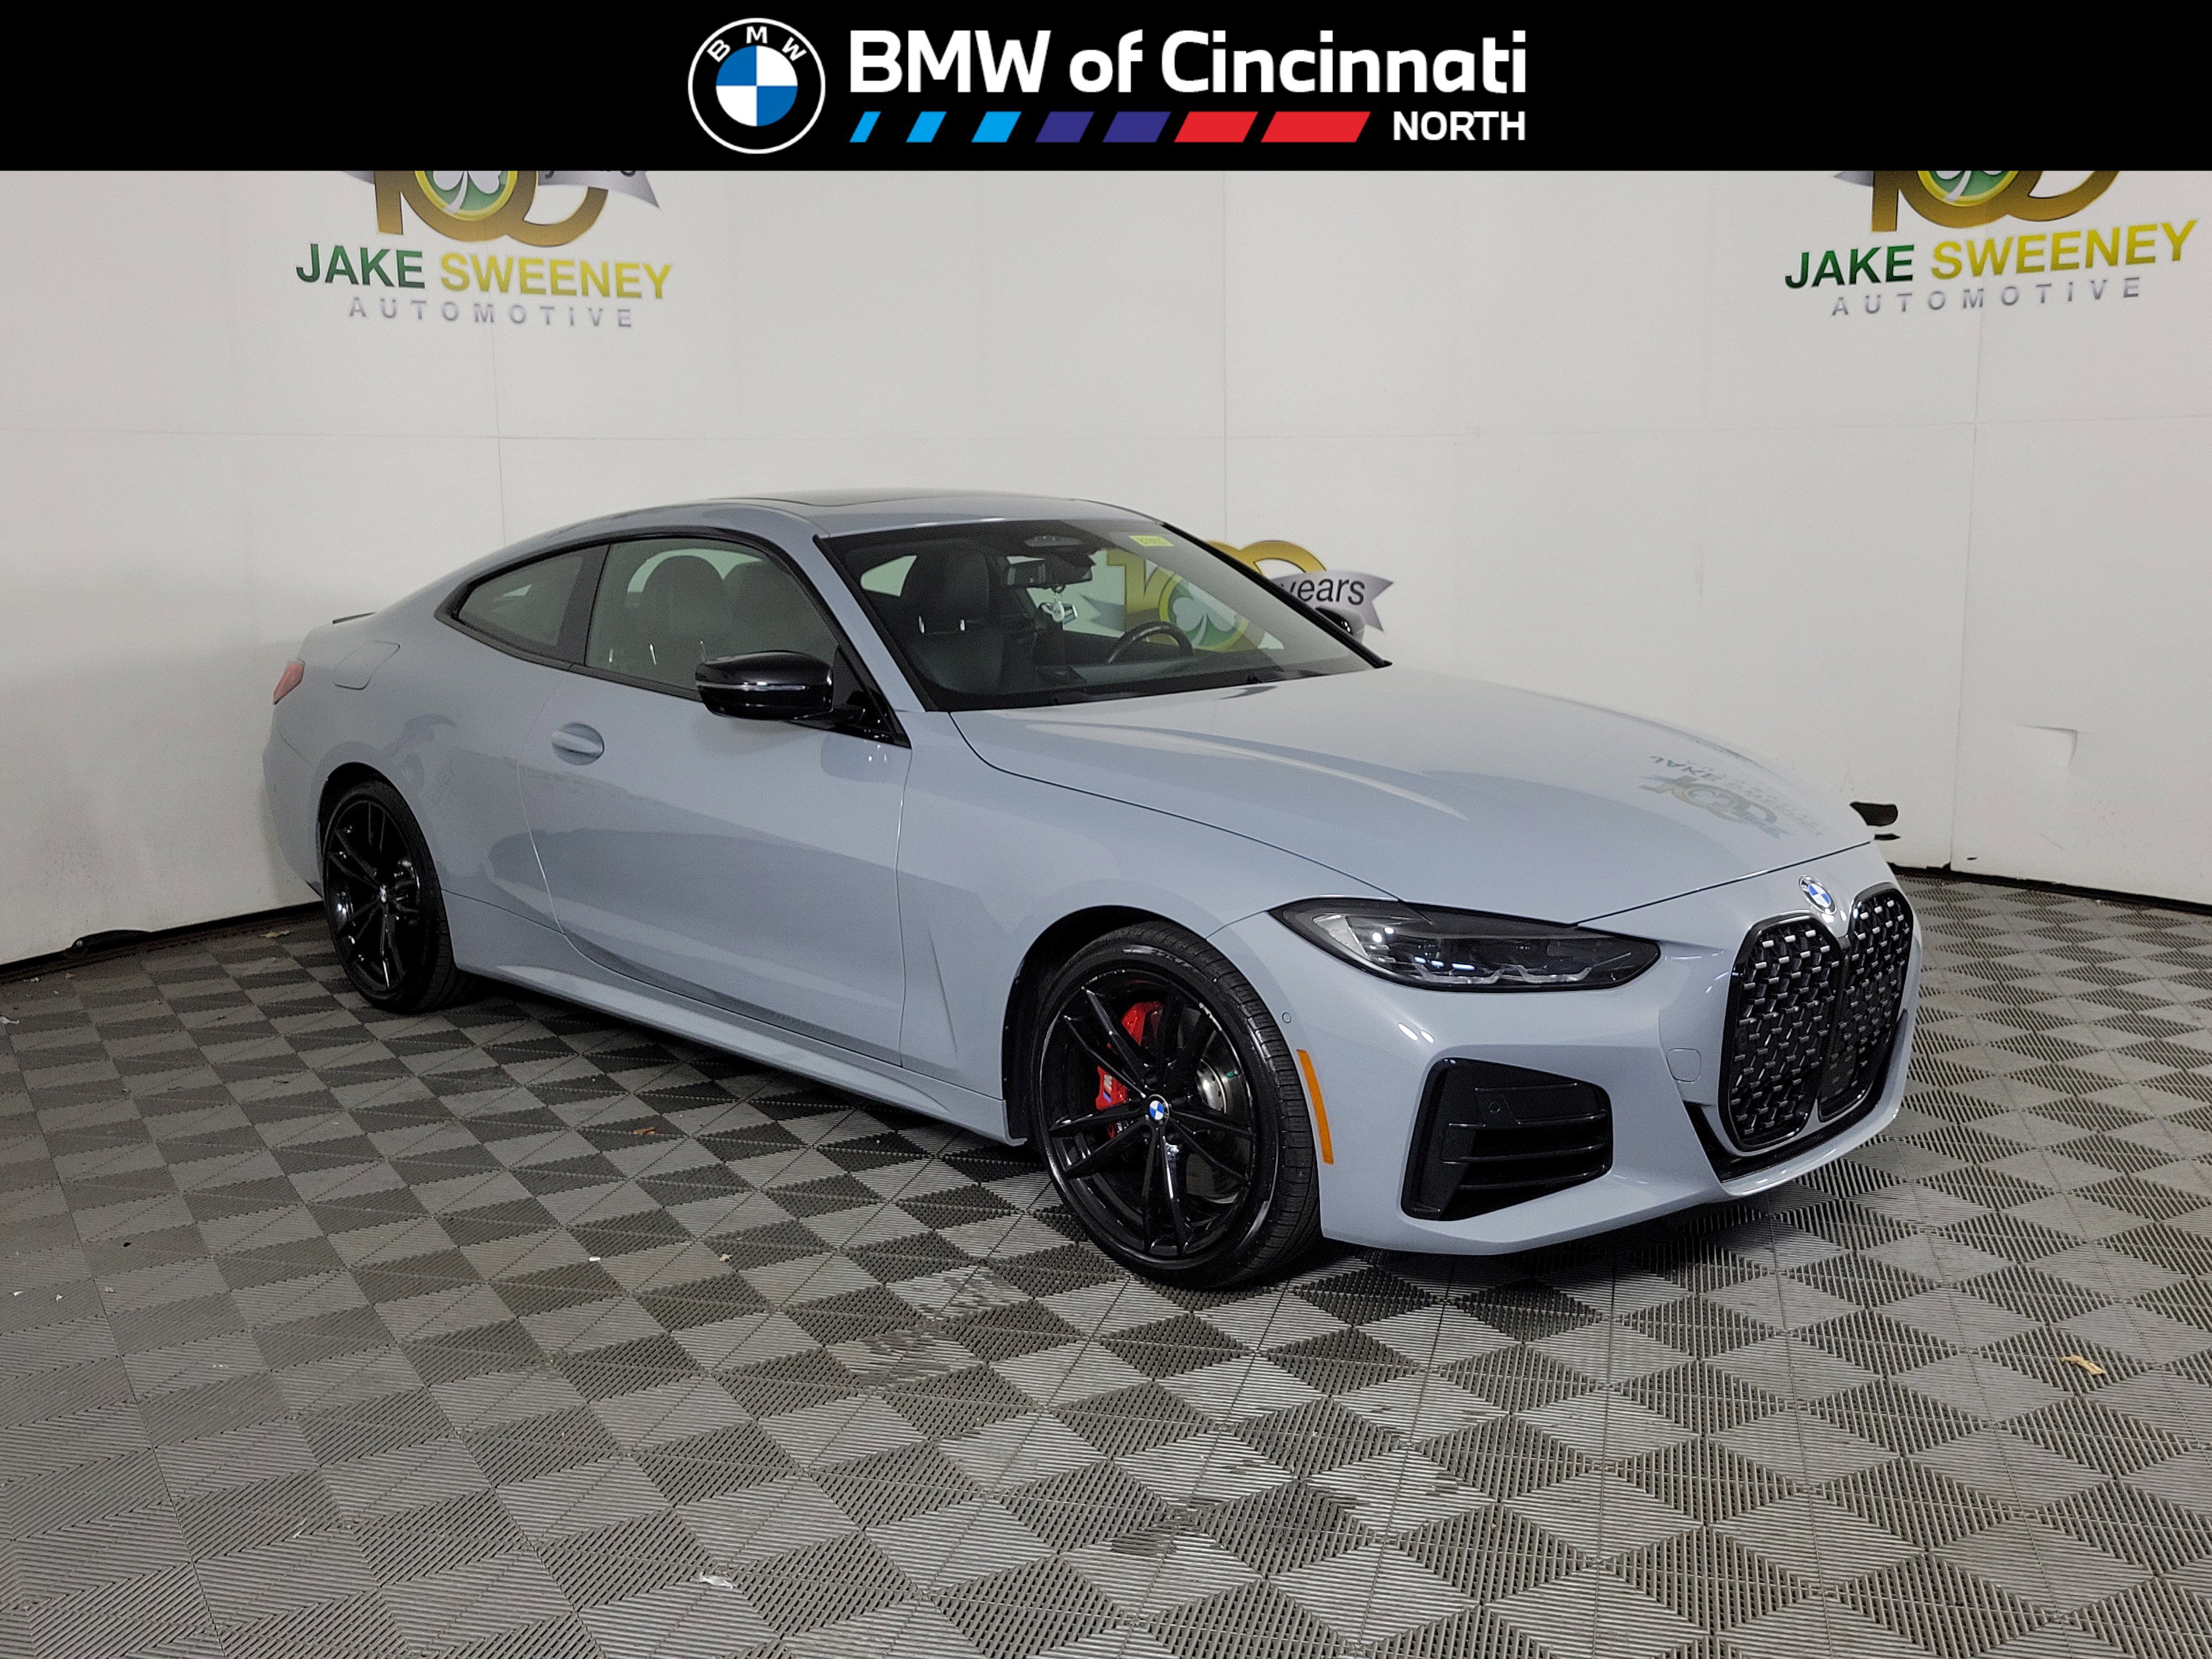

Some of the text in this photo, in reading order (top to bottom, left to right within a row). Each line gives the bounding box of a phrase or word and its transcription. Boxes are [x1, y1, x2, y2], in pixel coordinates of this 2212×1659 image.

[296, 243, 673, 300] JAKE SWEENEY
[1785, 219, 2198, 289] JAKE SWEENEY
[349, 297, 633, 328] AUTOMOTIVE
[1831, 276, 2141, 317] AUTOMOTIVE
